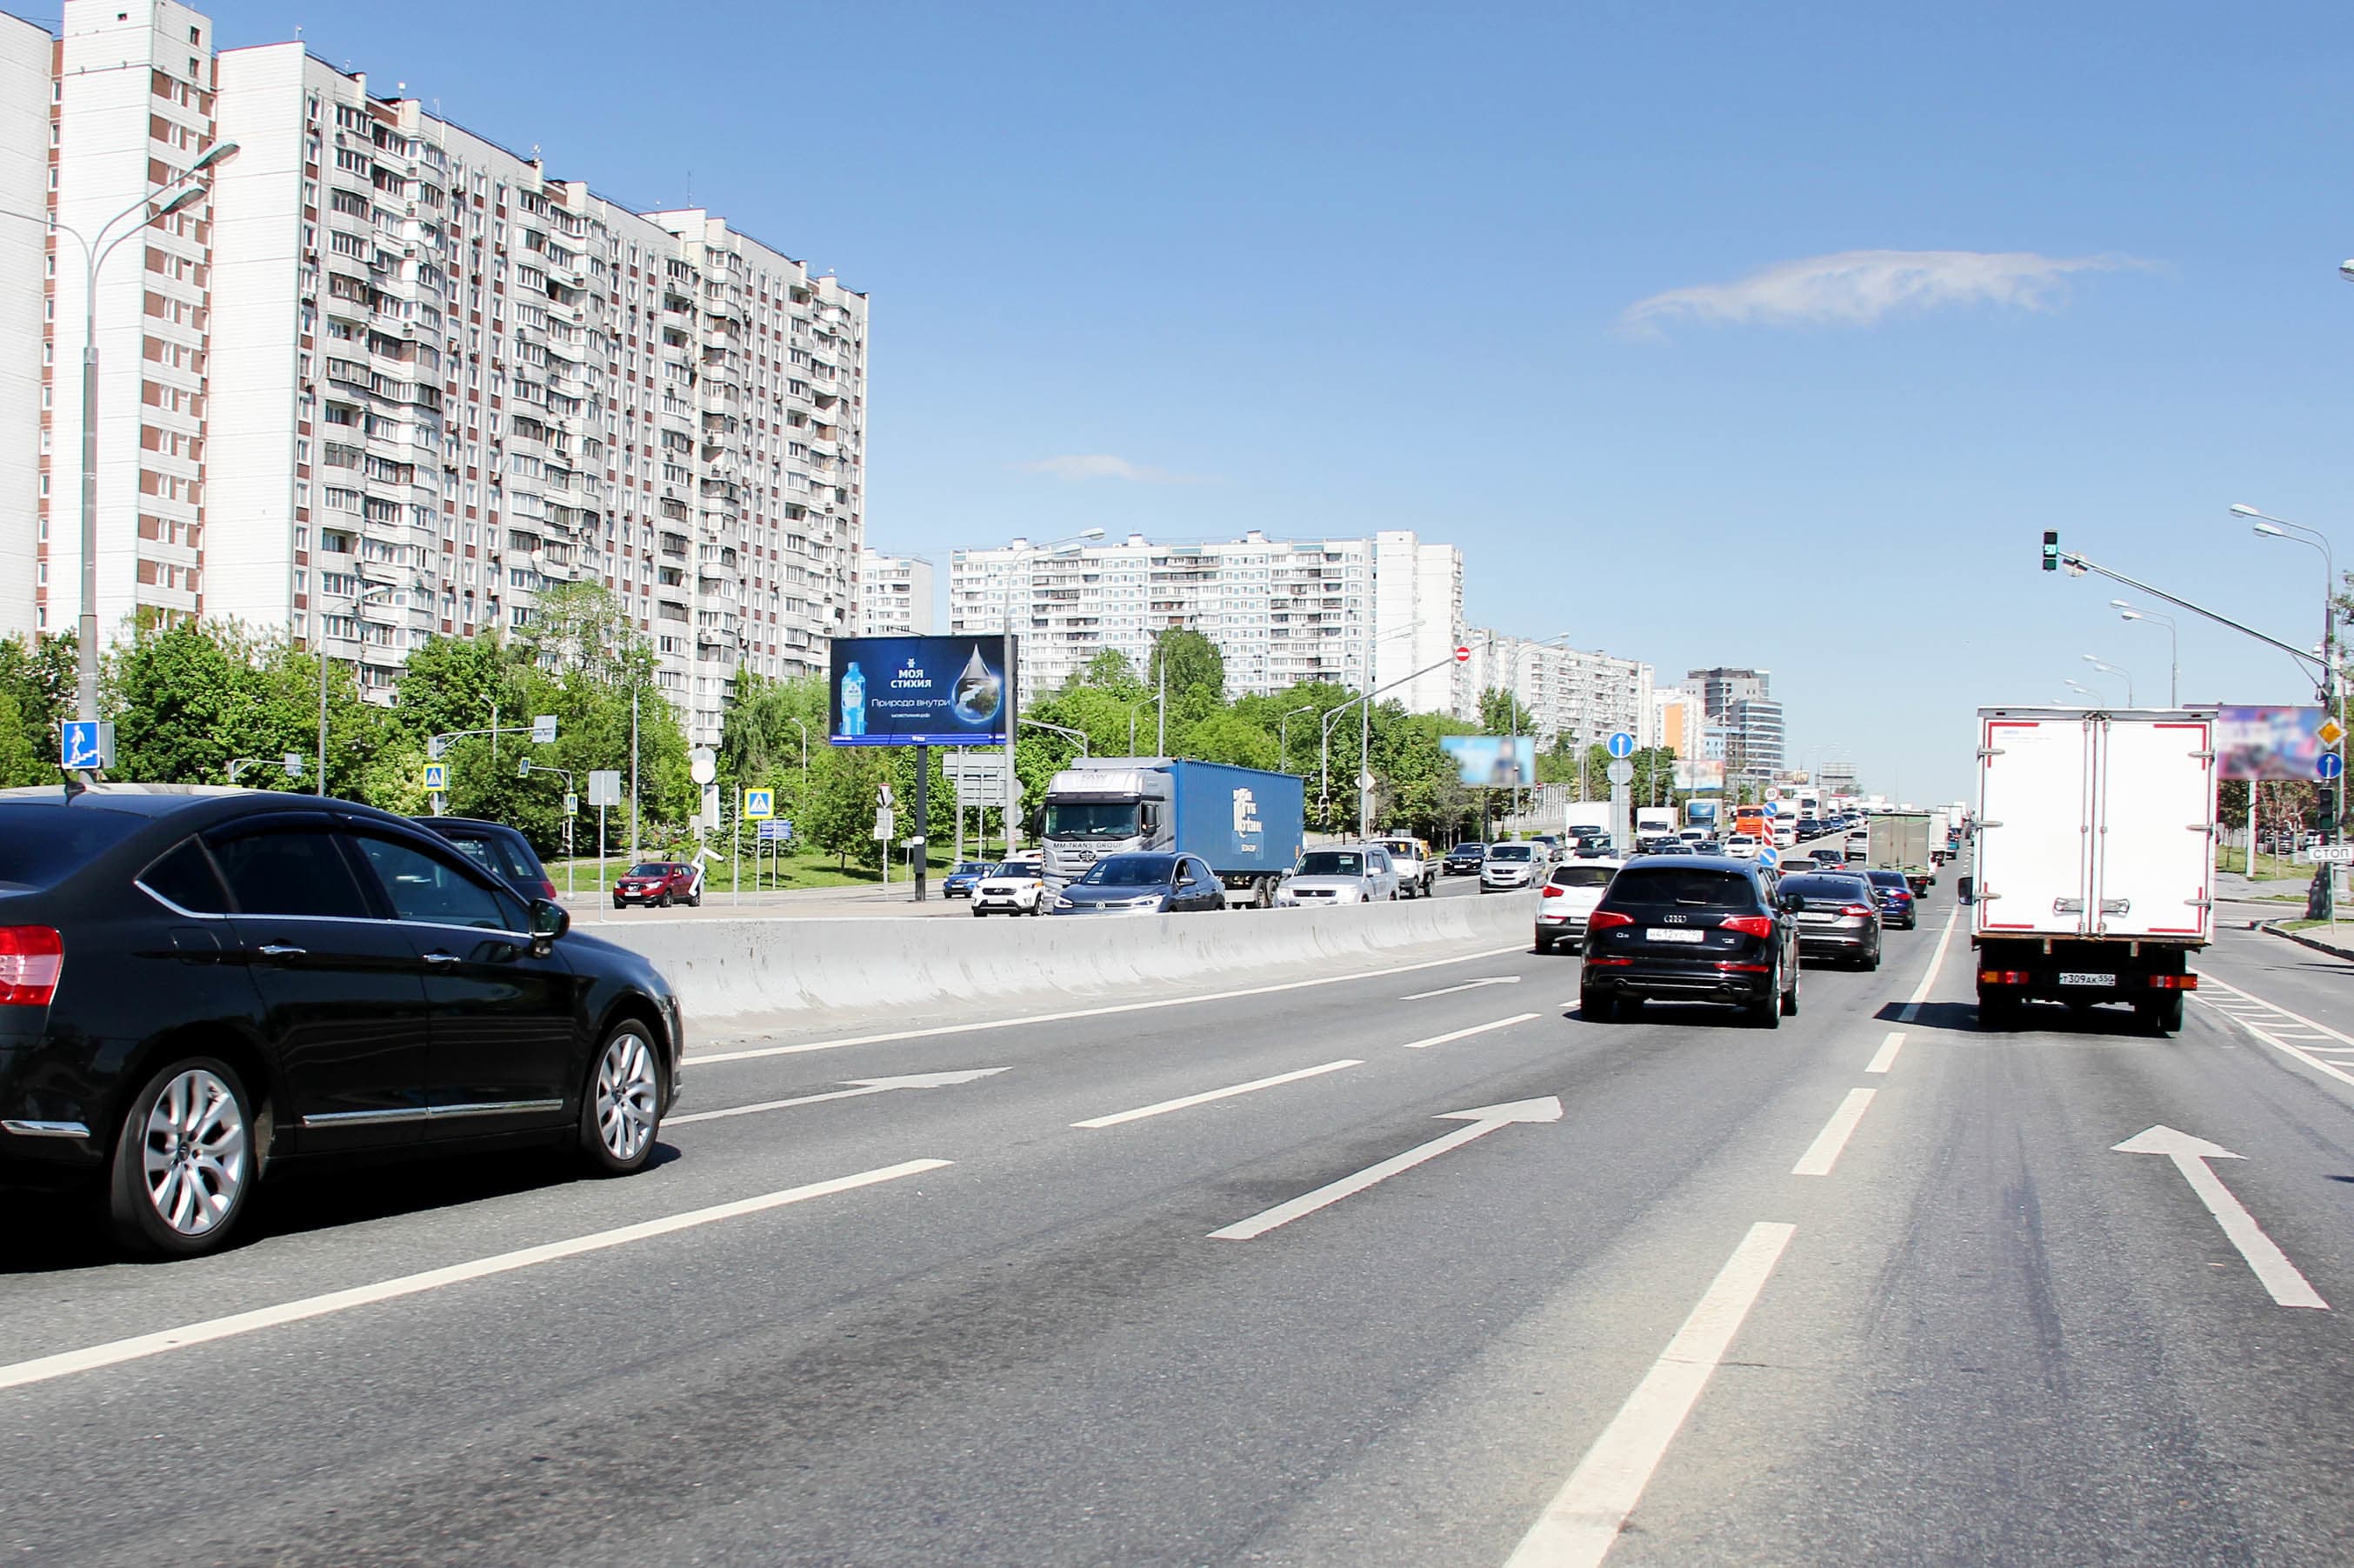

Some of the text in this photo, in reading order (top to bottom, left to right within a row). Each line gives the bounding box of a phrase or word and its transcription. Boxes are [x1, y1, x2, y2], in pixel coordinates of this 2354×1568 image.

[898, 669, 924, 678] МОЯ
[890, 679, 932, 689] СТИХИЯ
[871, 698, 951, 708] Природа внутри
[2313, 849, 2349, 859] СТОП
